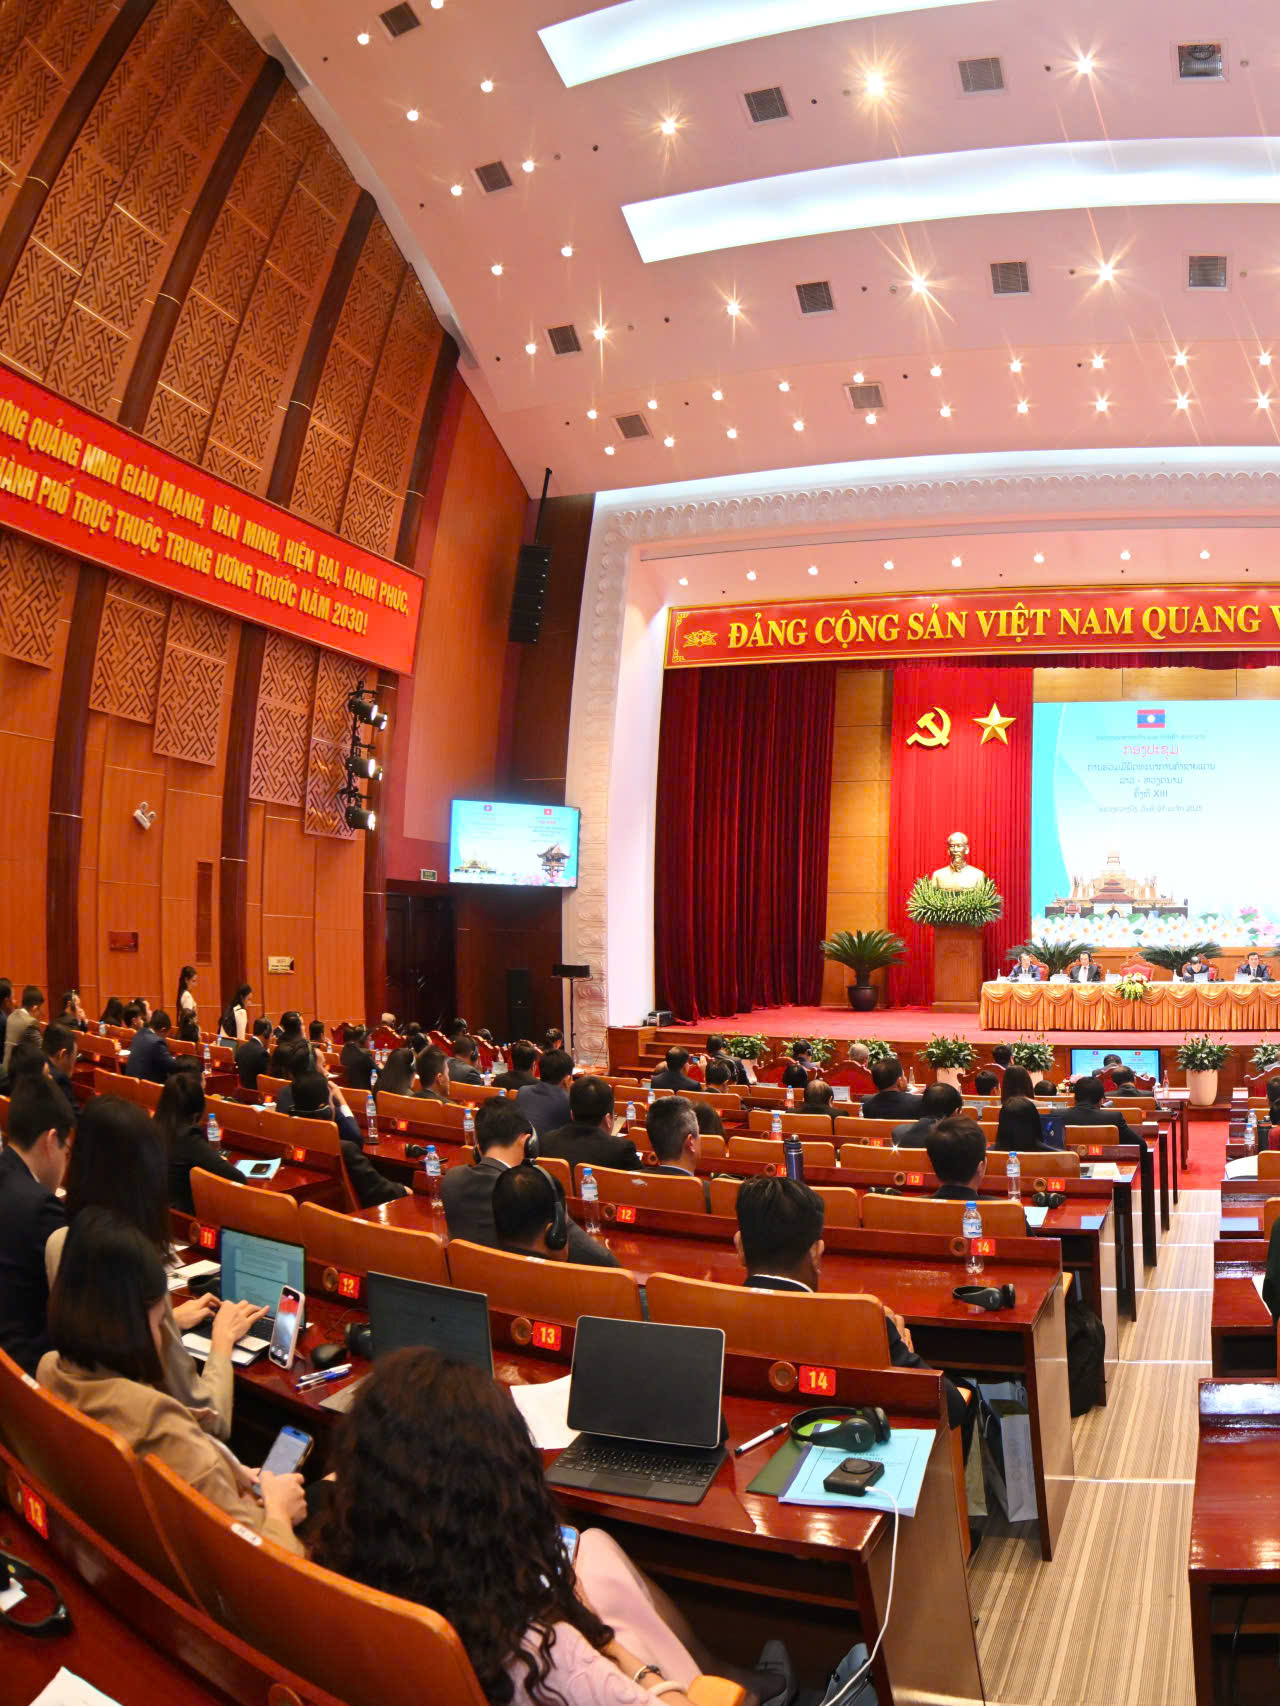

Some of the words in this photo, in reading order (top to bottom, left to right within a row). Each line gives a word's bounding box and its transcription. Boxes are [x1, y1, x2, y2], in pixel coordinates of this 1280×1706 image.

[28, 417, 82, 467] QUẢNG
[80, 443, 122, 485] NINH
[121, 463, 159, 502] GIÀU
[157, 480, 205, 528] MẠNH,
[211, 505, 240, 539] VĂN
[242, 519, 280, 561] MINH,
[283, 538, 315, 573] HIỆN
[343, 566, 378, 600] HẠNH
[37, 475, 75, 515] PHỐ
[72, 490, 113, 534] TRỰC
[114, 508, 163, 555] THUỘC
[165, 531, 213, 575] TRUNG
[214, 552, 253, 590] ƯƠNG
[255, 569, 298, 607] TRƯỚC
[299, 587, 331, 620] NĂM
[332, 602, 368, 635] 2030!
[728, 611, 808, 649] ĐẢNG
[814, 609, 900, 649] CỘNG
[906, 602, 968, 641] SẢN
[976, 602, 1051, 643] VIỆT
[1057, 606, 1135, 635] NAM
[1142, 604, 1261, 641] QUANG
[908, 1175, 920, 1184] 13
[621, 1208, 632, 1220] 12
[976, 1240, 990, 1253] 14
[343, 1277, 354, 1293] 12
[539, 1327, 557, 1346] 13
[808, 1370, 828, 1390] 14
